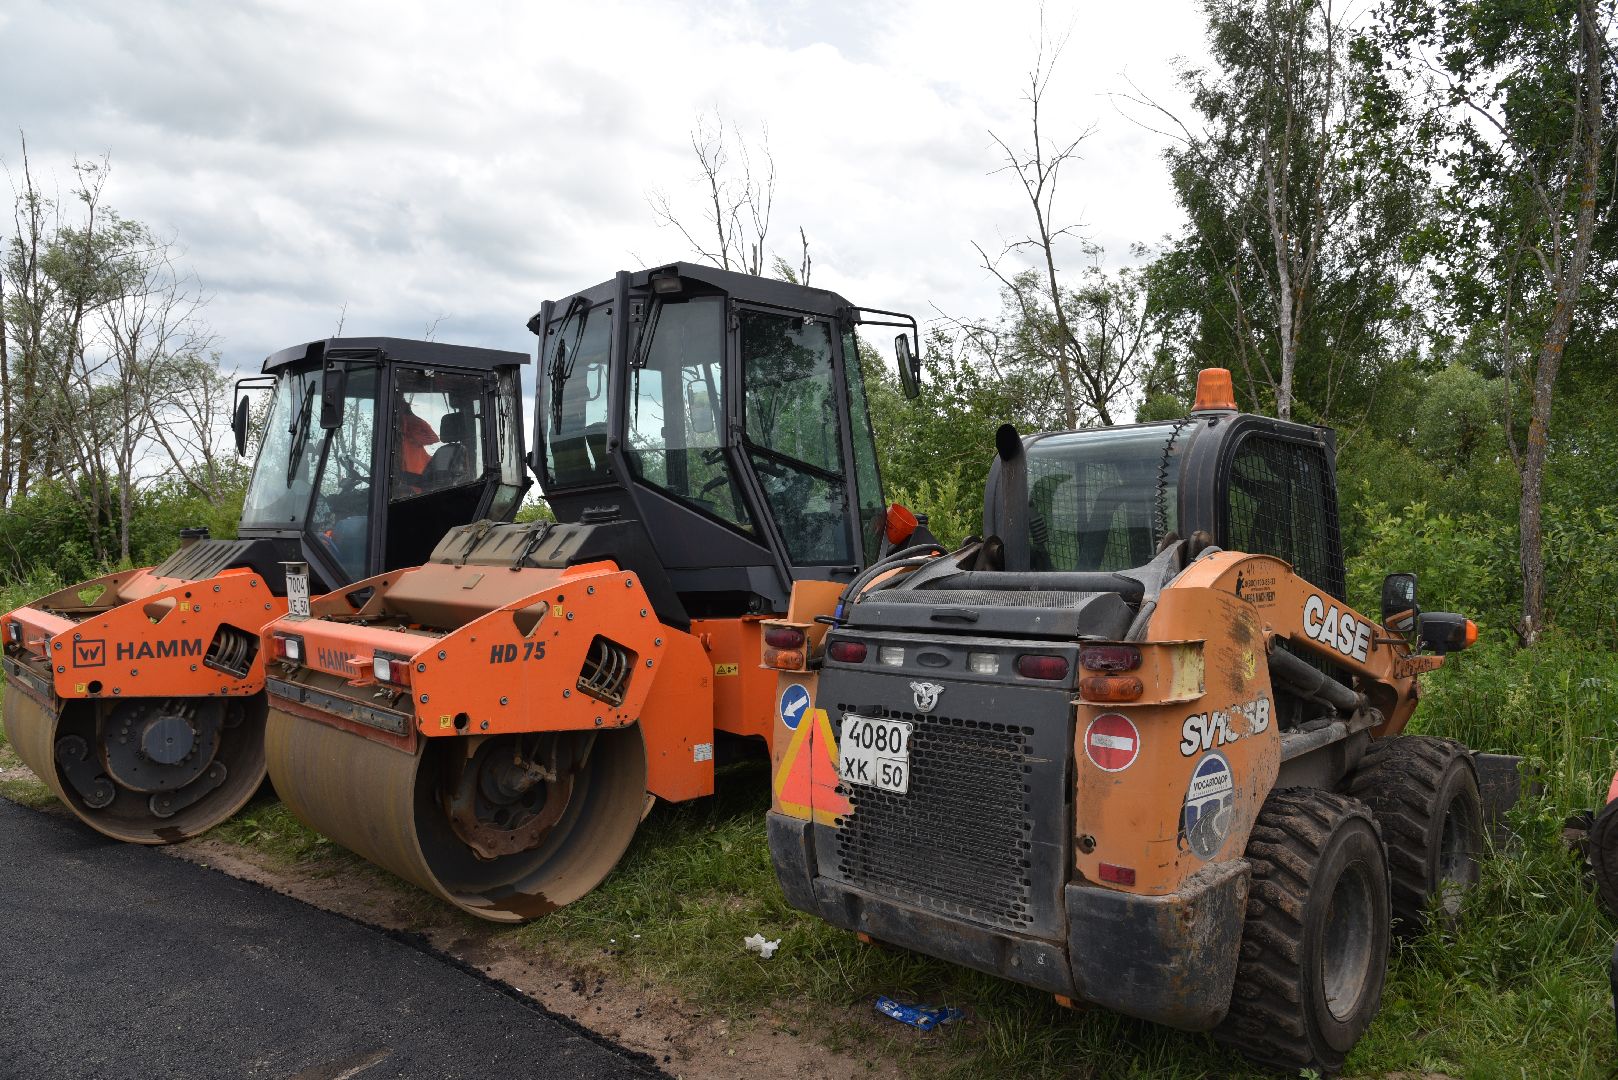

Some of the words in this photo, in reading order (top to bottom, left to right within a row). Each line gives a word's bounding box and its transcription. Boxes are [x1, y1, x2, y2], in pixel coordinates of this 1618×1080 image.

[288, 576, 306, 594] 7004
[300, 600, 308, 613] 50
[1303, 594, 1371, 664] CASE
[116, 639, 202, 660] HAMM
[490, 643, 518, 664] HD
[523, 641, 546, 661] 75
[849, 721, 902, 753] 4080
[881, 763, 903, 787] 50
